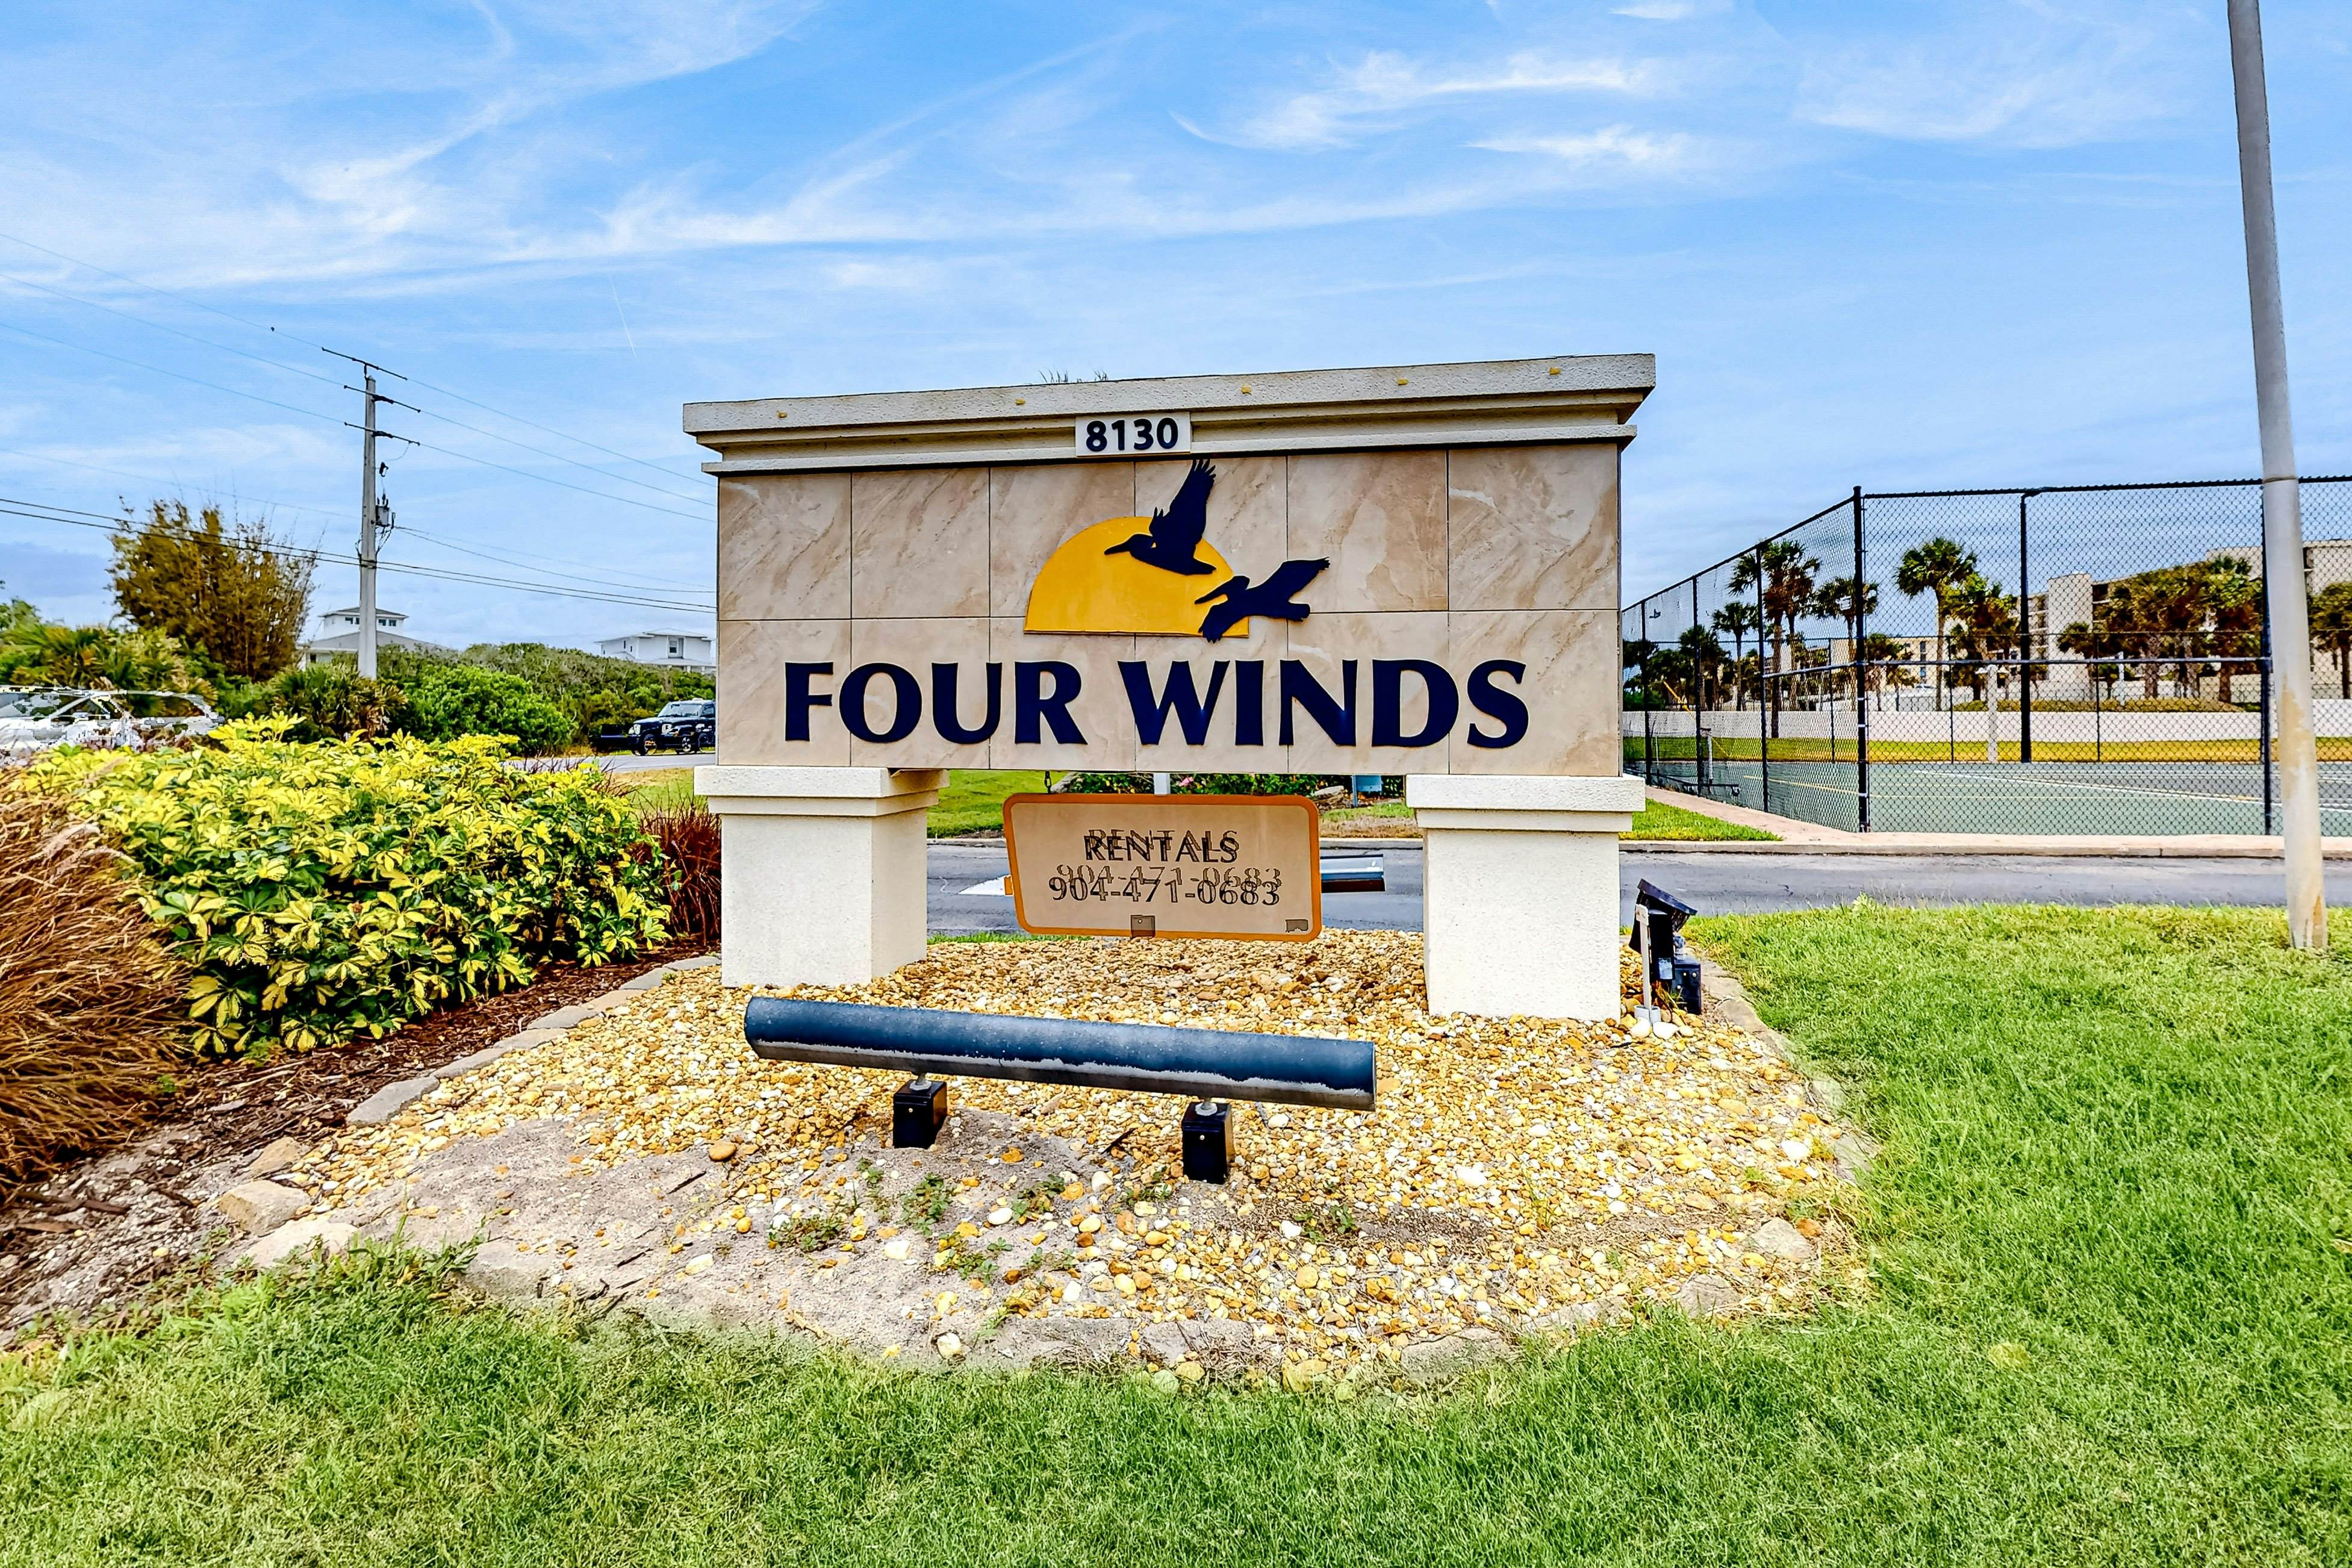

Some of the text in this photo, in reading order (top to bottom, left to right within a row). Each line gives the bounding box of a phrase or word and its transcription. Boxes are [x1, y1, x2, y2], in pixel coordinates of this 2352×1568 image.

[1086, 417, 1178, 452] 8130
[784, 658, 1530, 749] FOUR WINDS
[1084, 835, 1239, 863] RENTALS
[1048, 876, 1281, 906] 904-471-0683
